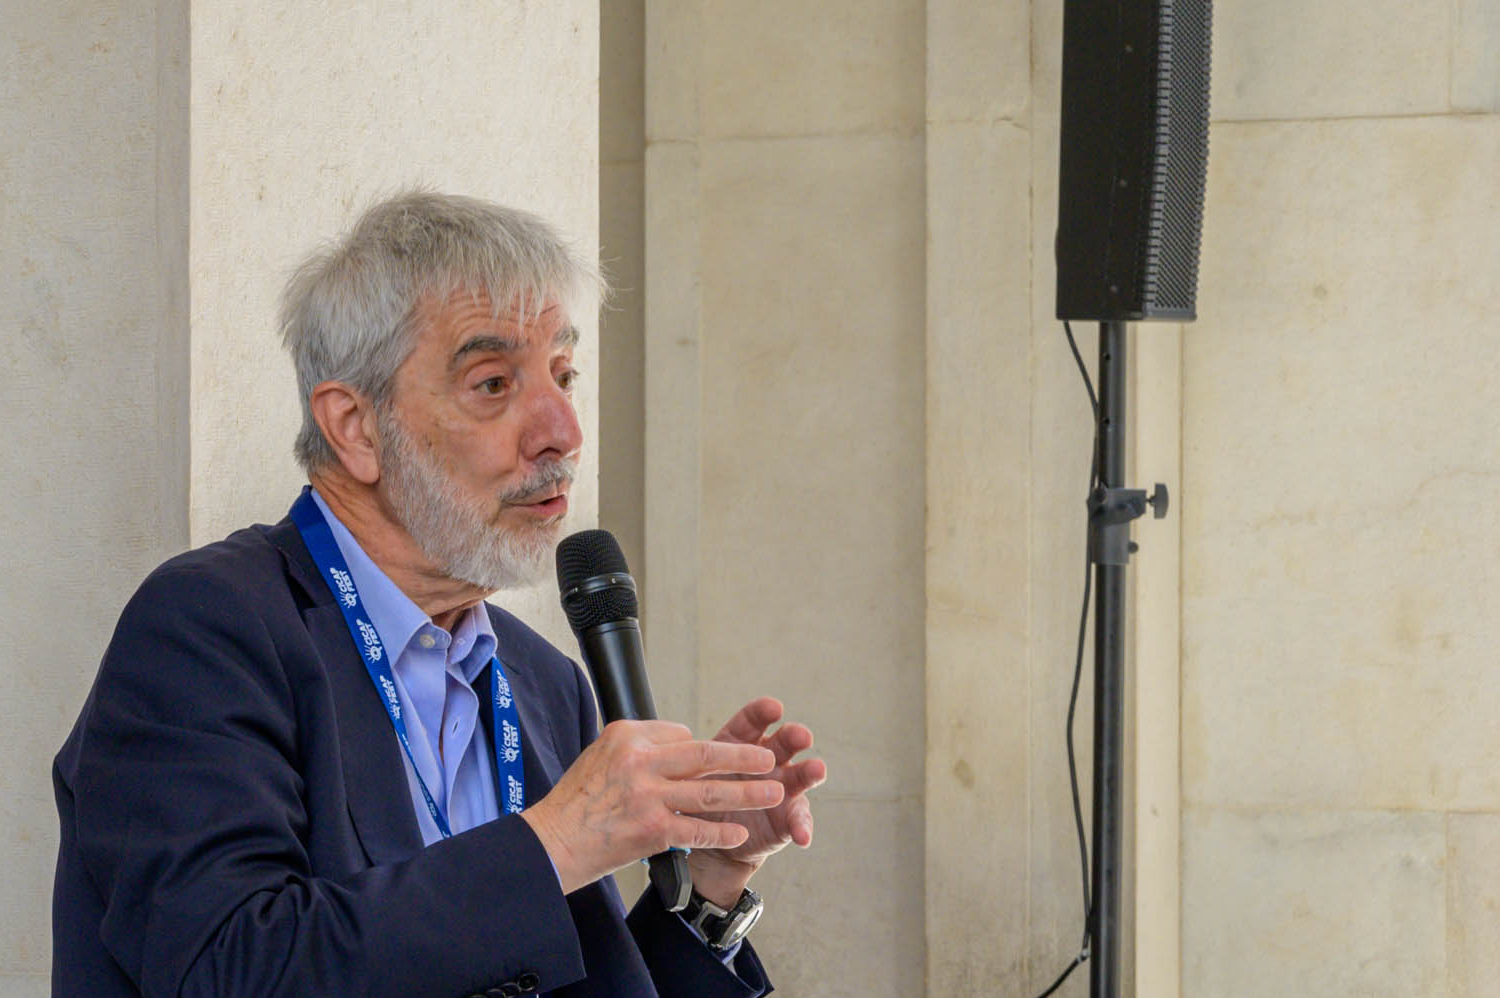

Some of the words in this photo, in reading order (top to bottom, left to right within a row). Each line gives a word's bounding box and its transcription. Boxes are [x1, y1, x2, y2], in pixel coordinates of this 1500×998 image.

[356, 618, 373, 645] CICAP
[364, 623, 380, 645] FEST
[502, 719, 511, 747] CICAP
[511, 725, 520, 748] FEST
[507, 775, 516, 803] CICAP
[515, 781, 523, 805] FEST
